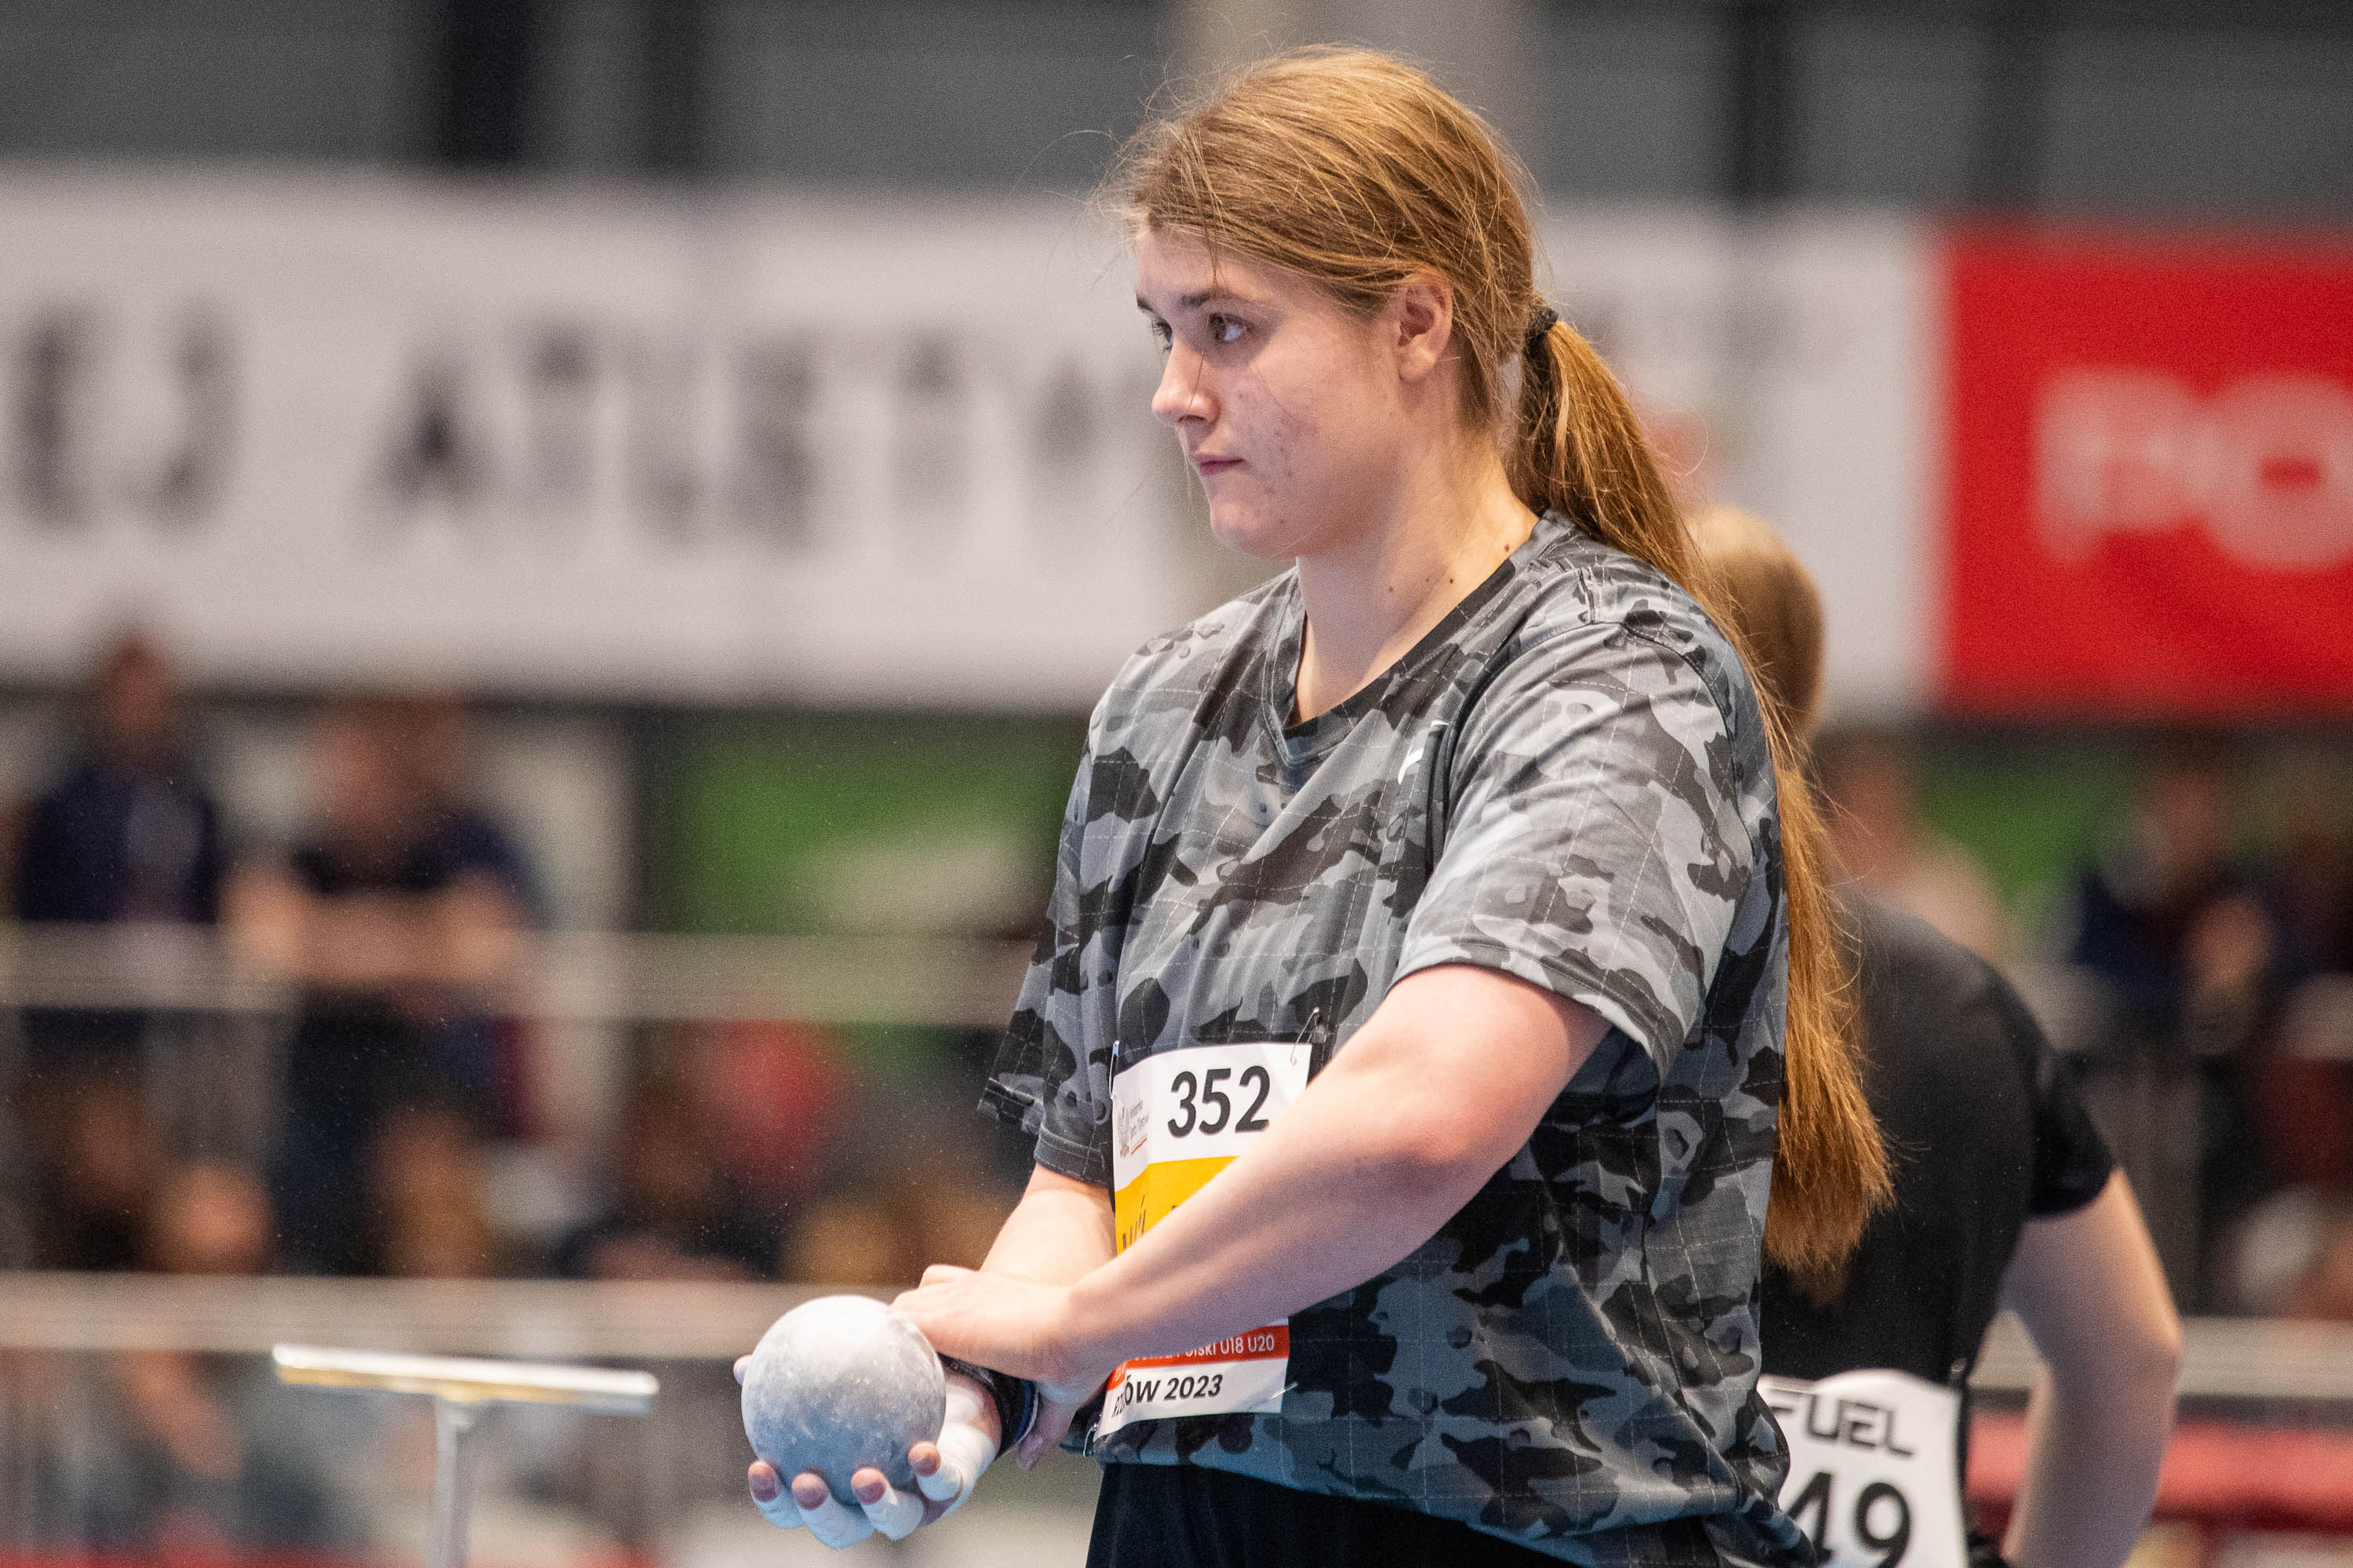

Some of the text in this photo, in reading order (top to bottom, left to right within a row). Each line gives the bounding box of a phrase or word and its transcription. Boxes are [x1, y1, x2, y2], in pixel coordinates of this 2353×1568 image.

[1167, 1064, 1271, 1139] 352
[1220, 1337, 1244, 1355] U18
[1248, 1334, 1275, 1352] U20
[1164, 1374, 1224, 1401] 2023
